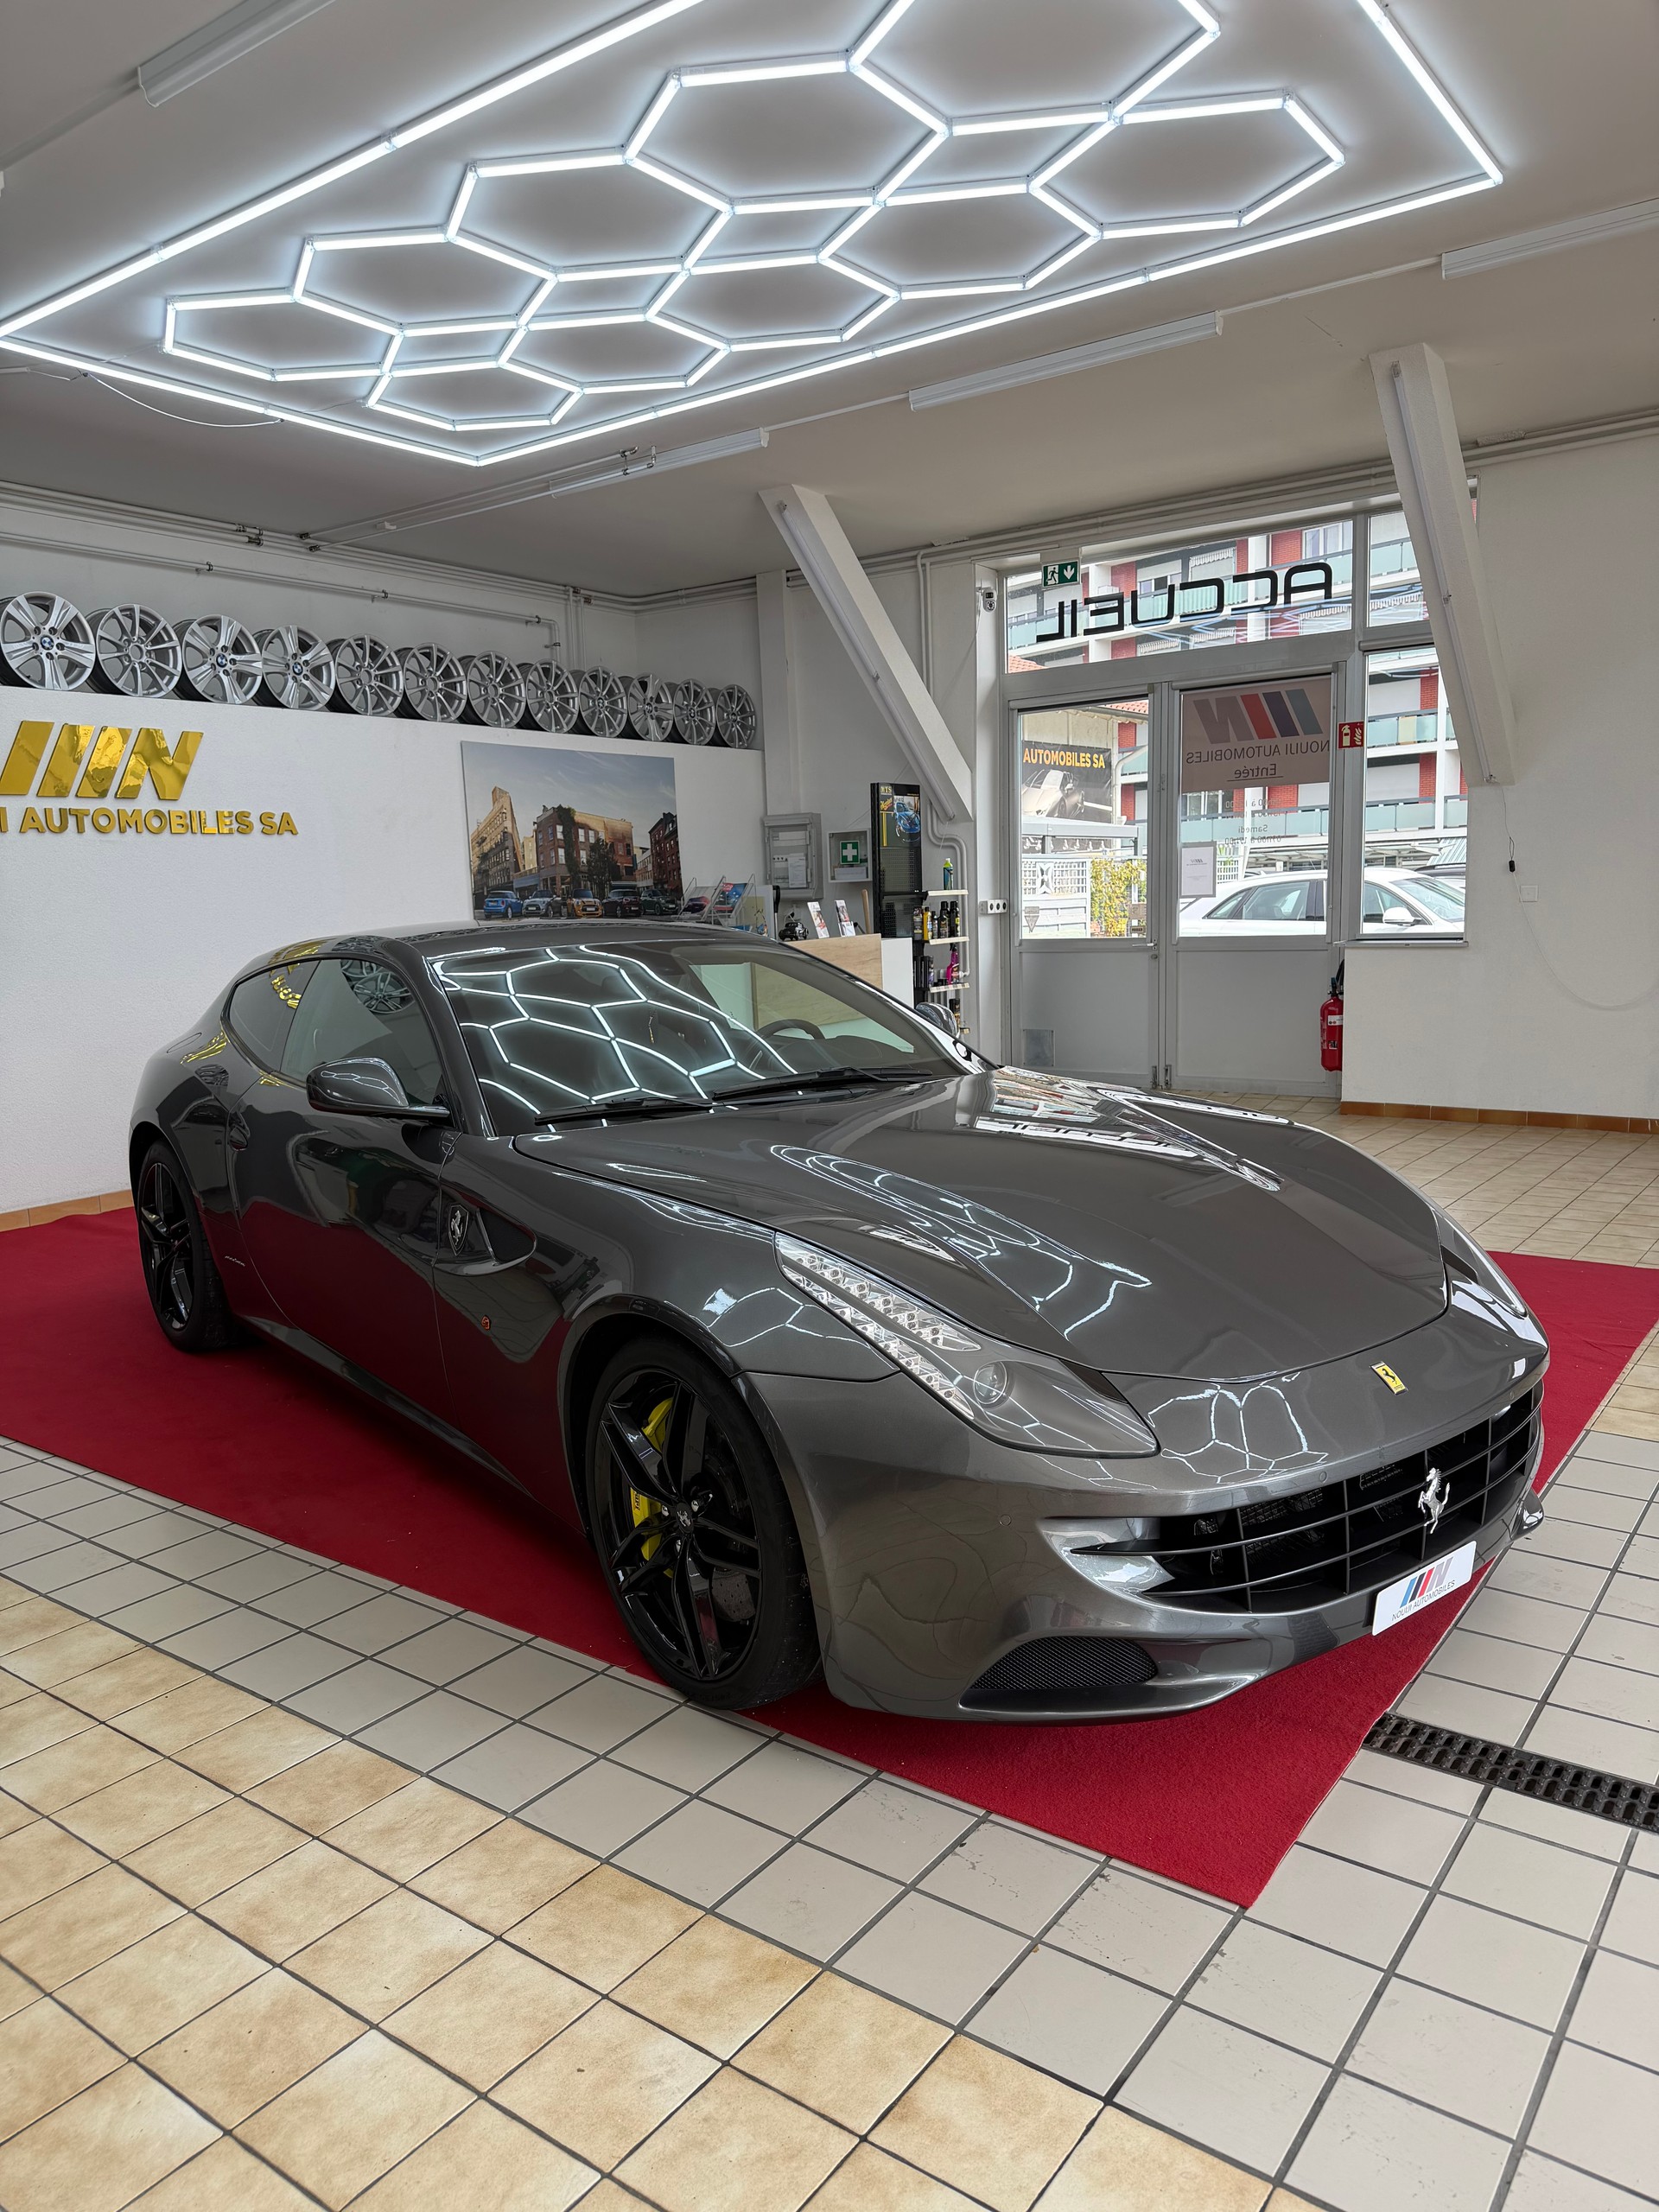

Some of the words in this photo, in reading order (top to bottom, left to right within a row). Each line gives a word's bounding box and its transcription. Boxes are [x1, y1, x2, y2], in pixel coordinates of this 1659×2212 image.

[1023, 748, 1091, 767] AUTOMOBILES
[1092, 753, 1105, 768] SA
[20, 807, 254, 835] AUTOMOBILES
[259, 811, 298, 835] SA
[1413, 1580, 1455, 1609] AUTOMOBILES
